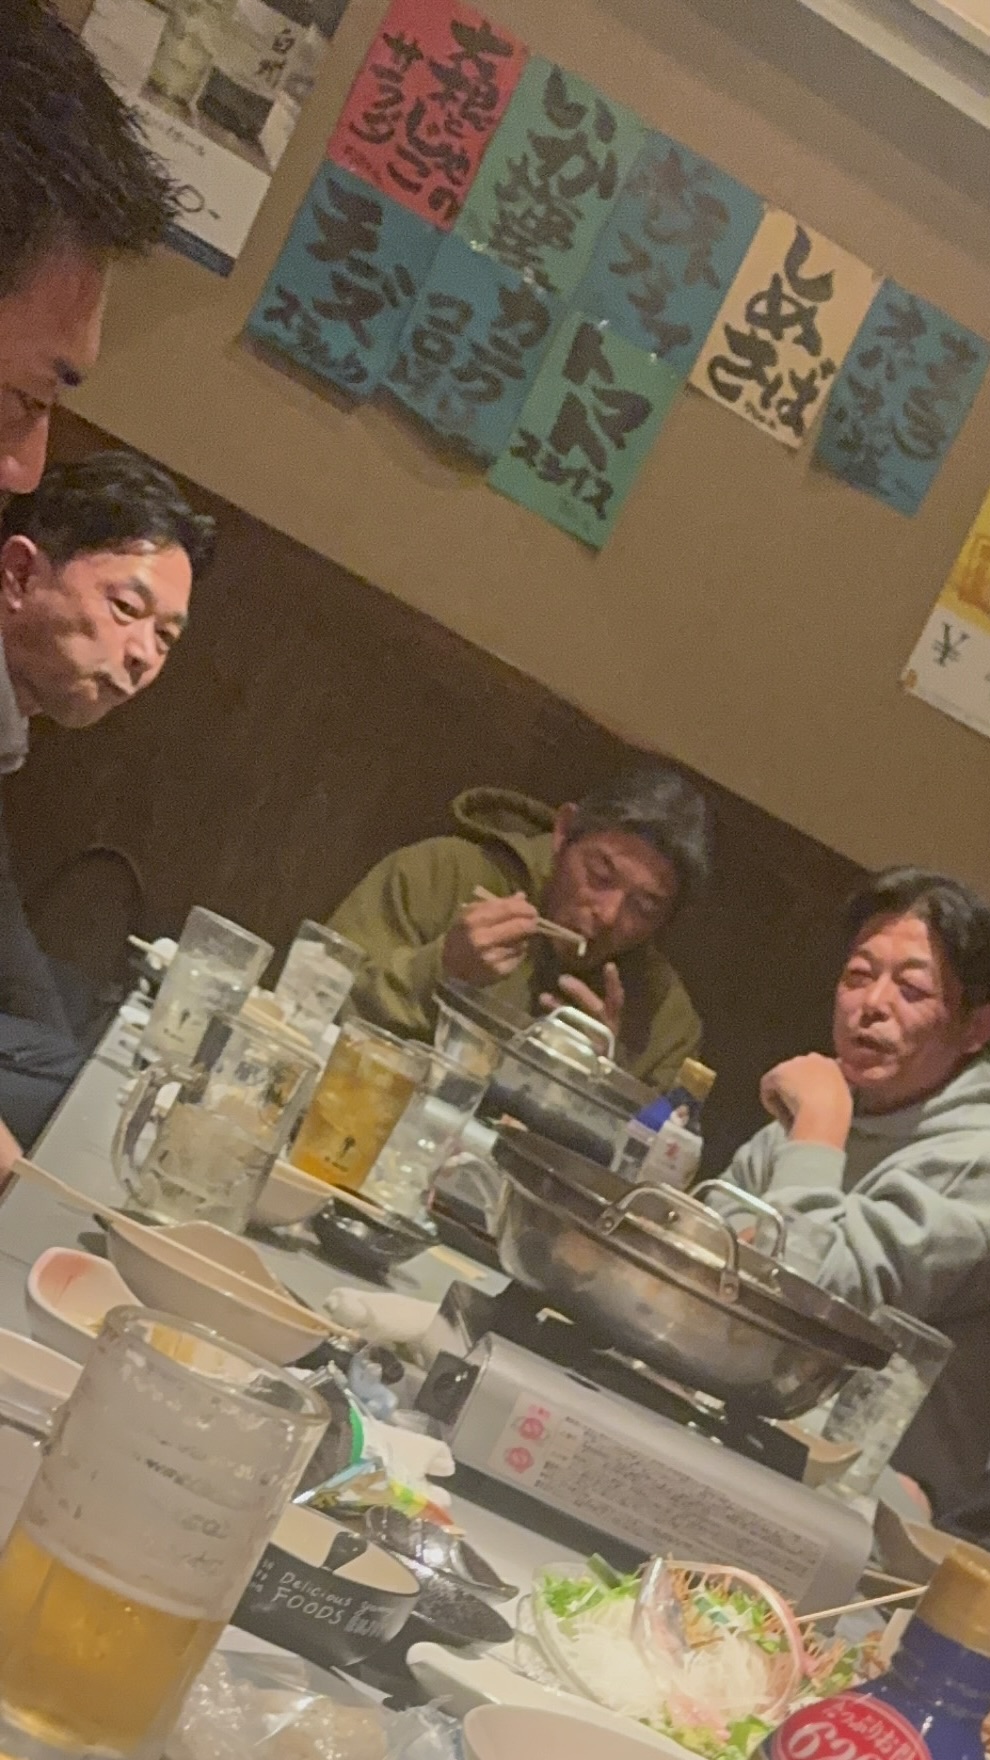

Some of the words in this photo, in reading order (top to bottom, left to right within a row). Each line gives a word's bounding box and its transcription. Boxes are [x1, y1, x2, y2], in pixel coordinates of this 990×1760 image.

[706, 224, 837, 438] しめさば
[549, 321, 654, 472] トマト
[930, 621, 970, 668] ¥
[270, 1586, 345, 1627] FOODS
